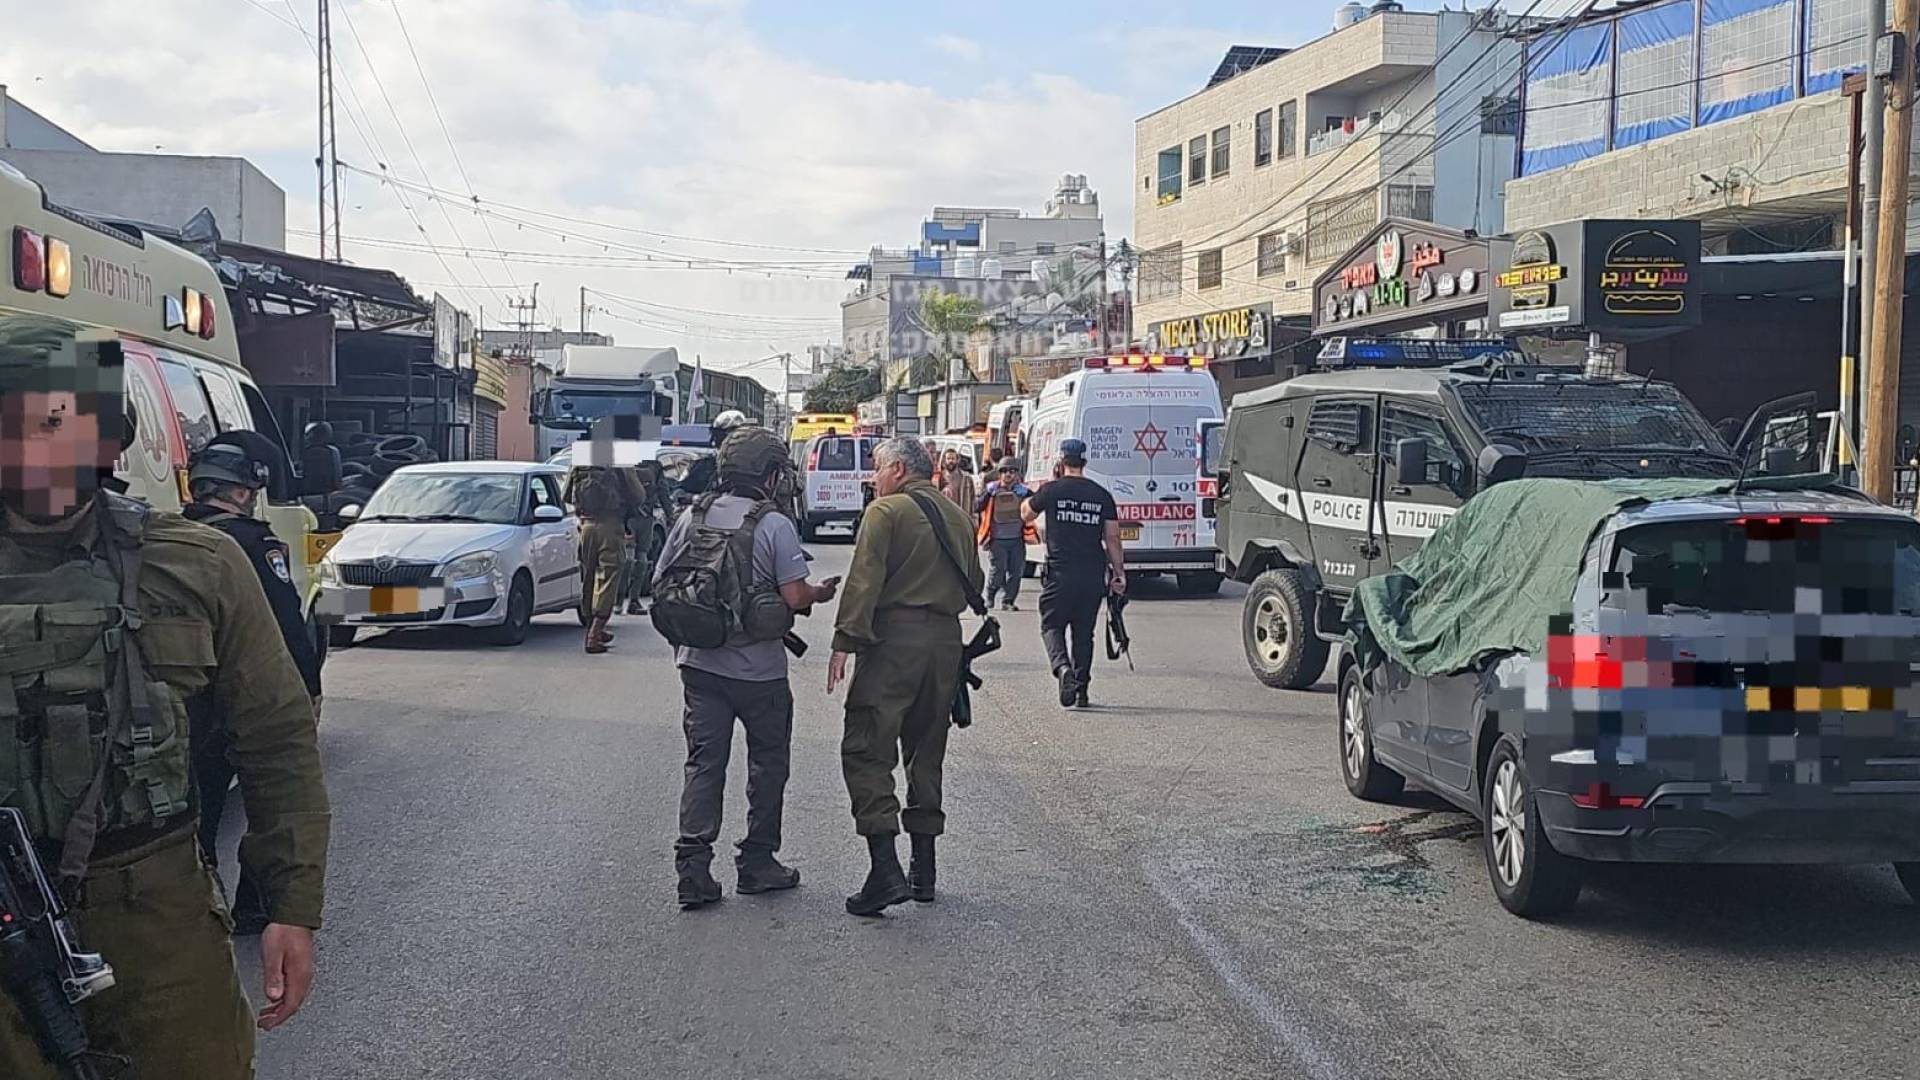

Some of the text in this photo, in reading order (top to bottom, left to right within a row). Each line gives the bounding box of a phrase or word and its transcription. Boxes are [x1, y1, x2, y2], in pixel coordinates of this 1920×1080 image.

[82, 254, 152, 308] חיל הרפואה
[1600, 268, 1689, 288] ستريت برجر
[1160, 317, 1197, 349] MEGA
[1202, 308, 1249, 343] STORE
[1090, 426, 1123, 435] MAGEN
[1090, 435, 1119, 443] DAVID
[1090, 443, 1119, 451] ADOM
[1102, 451, 1132, 460] ISRAEL
[1117, 505, 1195, 520] MBULANC
[1313, 499, 1363, 521] POLICE
[1057, 511, 1100, 525] אבטחה
[1173, 533, 1196, 547] 711
[1323, 559, 1357, 577] הגבול
